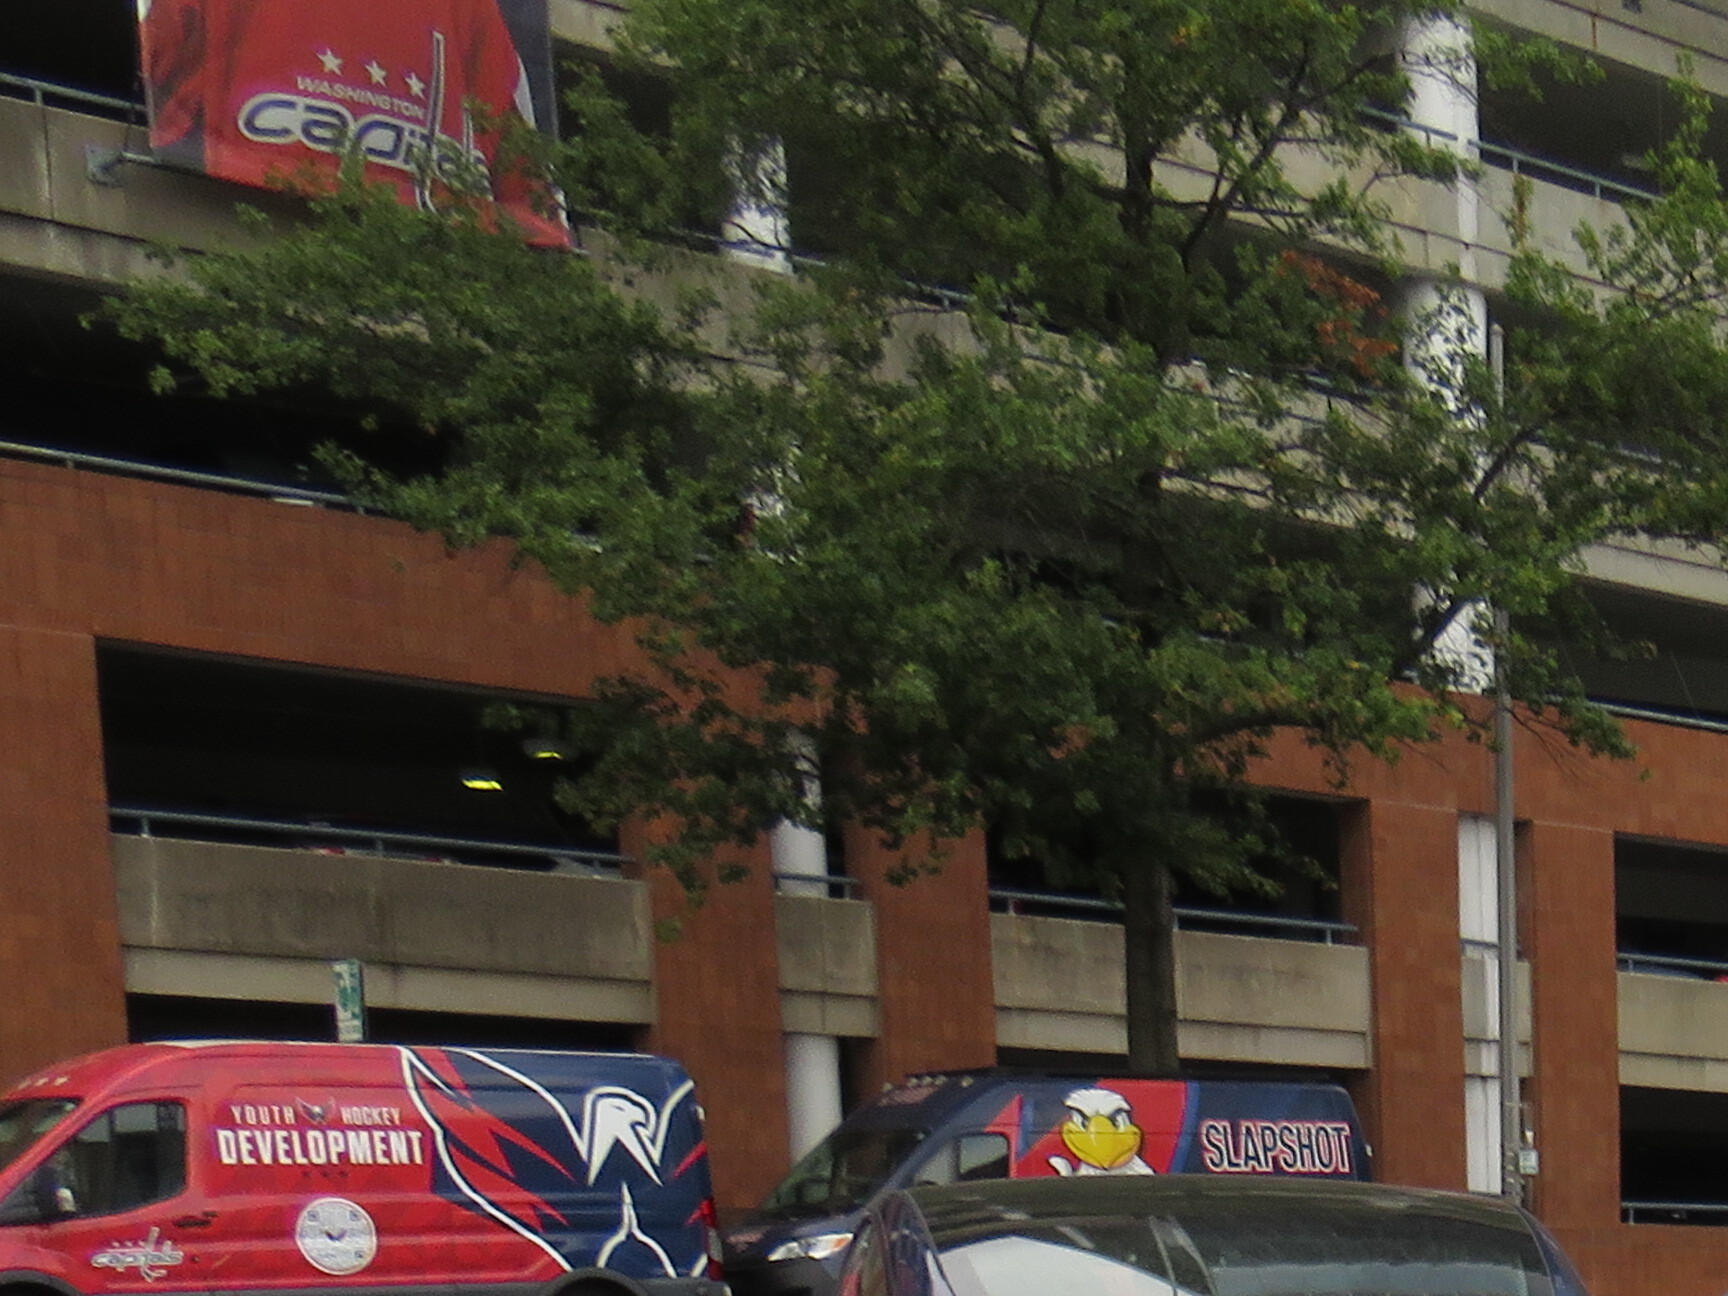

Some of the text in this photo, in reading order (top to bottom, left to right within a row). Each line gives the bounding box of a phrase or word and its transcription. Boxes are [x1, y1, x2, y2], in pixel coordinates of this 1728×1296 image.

[297, 75, 425, 119] WASHINGTON
[230, 1105, 402, 1126] YOUTH HOCKEY
[216, 1129, 424, 1165] DEVELOPMENT
[1200, 1119, 1351, 1173] SLAPSHOT
